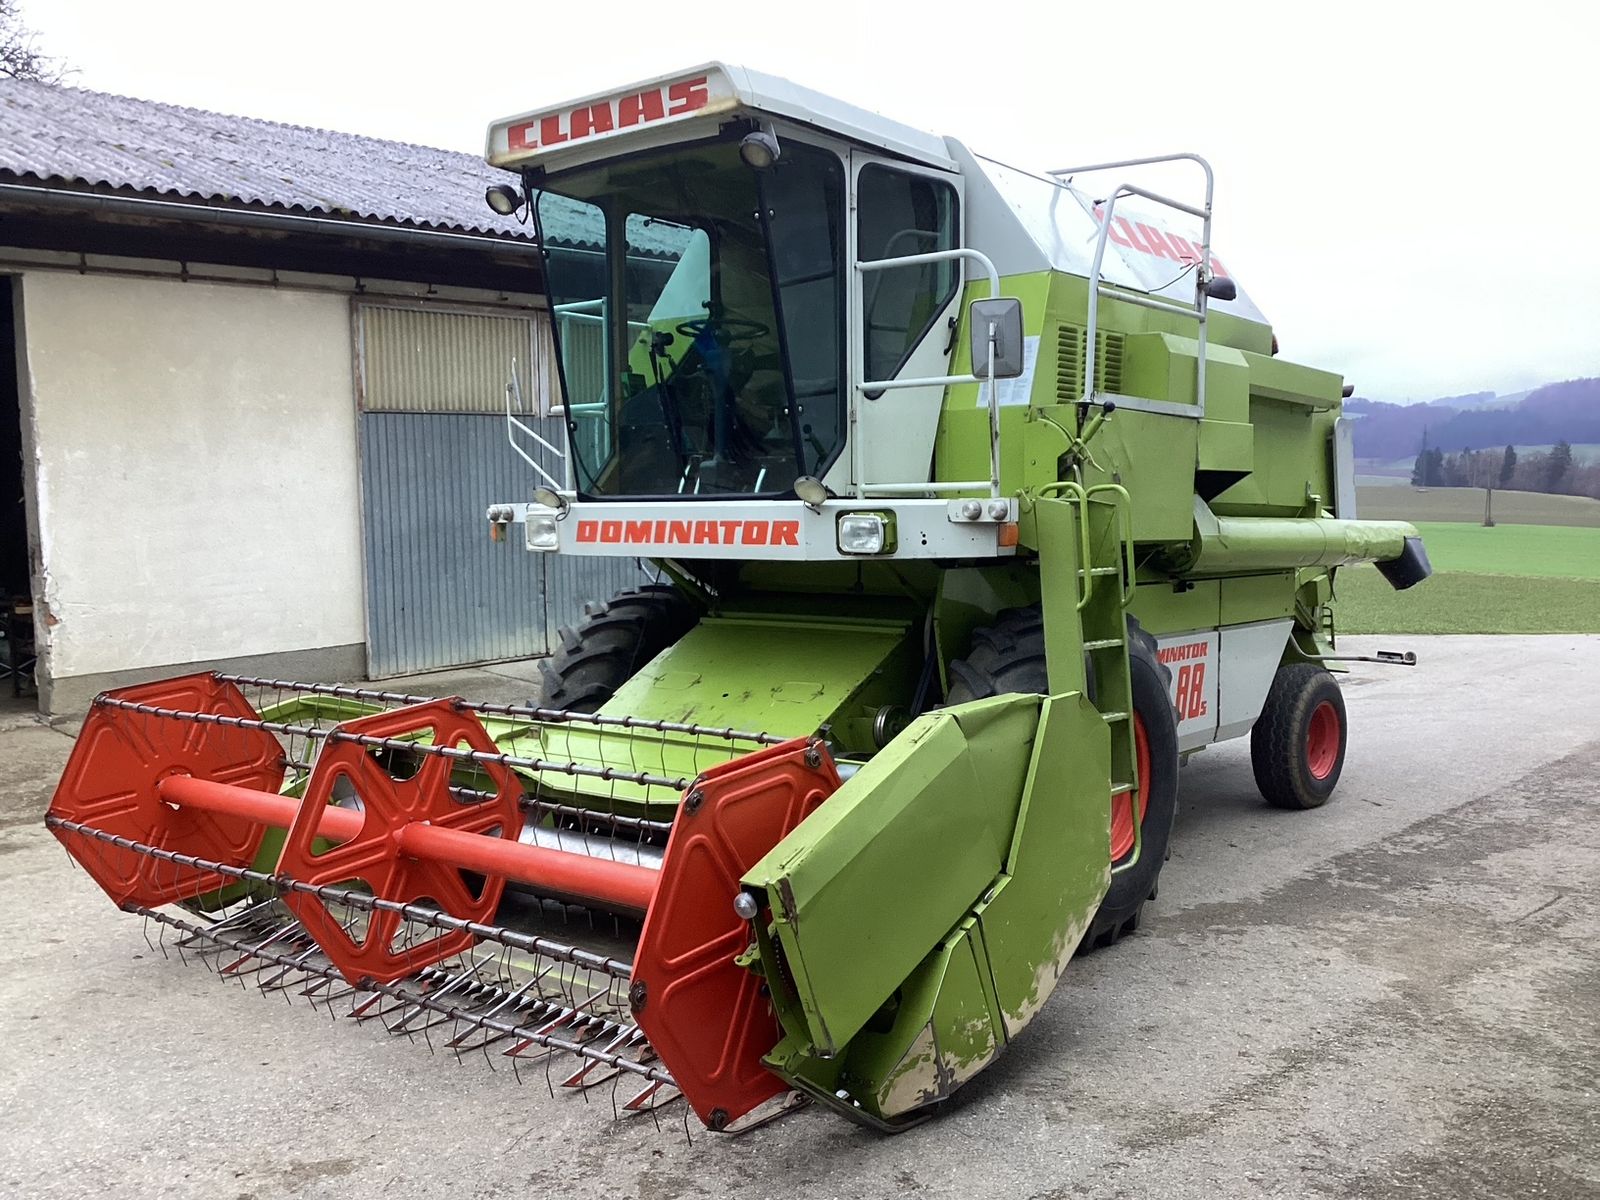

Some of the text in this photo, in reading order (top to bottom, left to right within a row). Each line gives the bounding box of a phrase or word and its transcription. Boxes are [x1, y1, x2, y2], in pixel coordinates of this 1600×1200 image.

[507, 76, 709, 153] CLAAS
[575, 520, 800, 546] DOMINATOR
[1156, 641, 1208, 664] MINATOR
